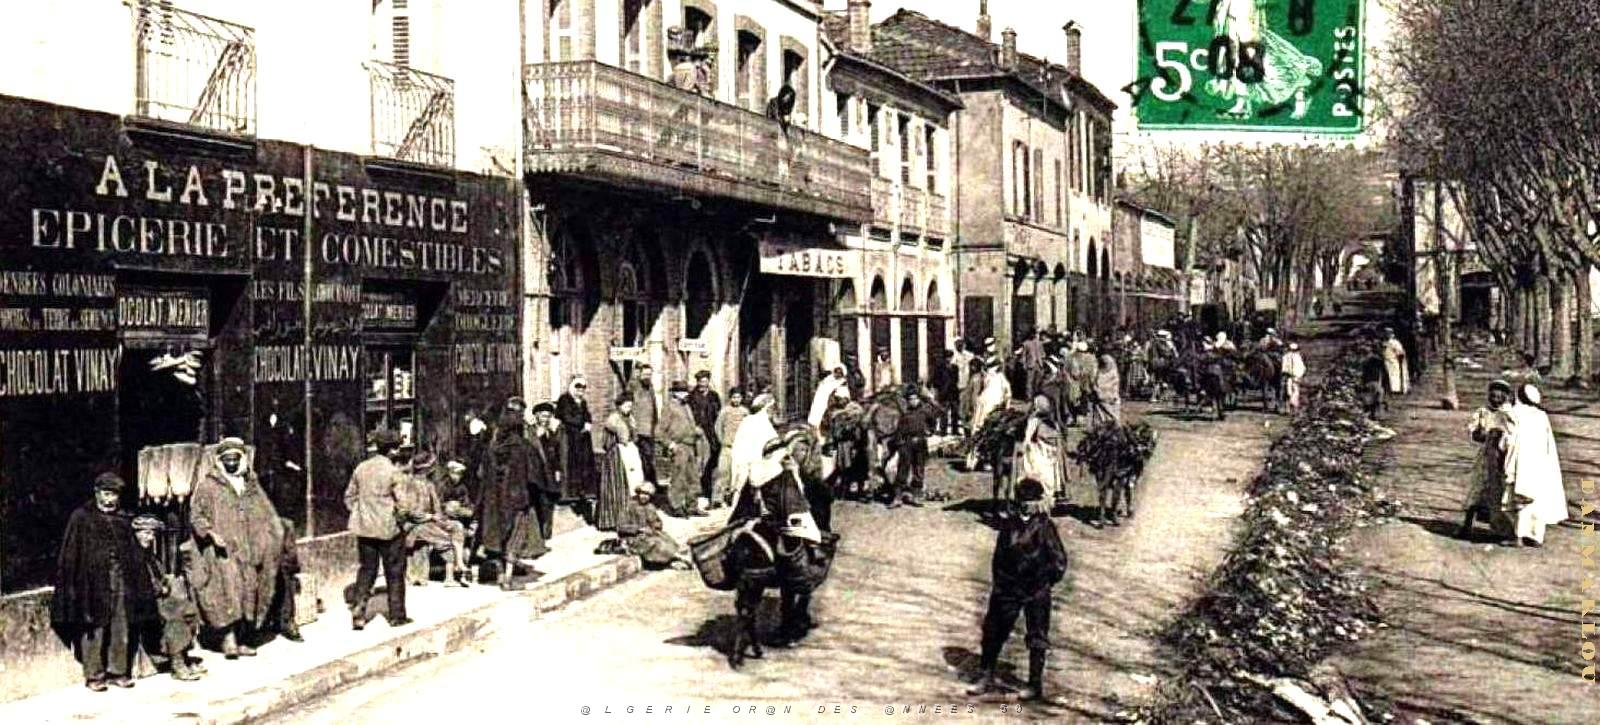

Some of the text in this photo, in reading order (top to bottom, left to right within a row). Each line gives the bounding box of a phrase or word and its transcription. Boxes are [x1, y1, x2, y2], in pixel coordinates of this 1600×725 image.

[1332, 26, 1356, 117] POSTES
[95, 155, 129, 197] A
[222, 168, 468, 233] PREFERENCE
[32, 208, 501, 274] EPICERIE ET COMESTIBLES
[119, 297, 164, 326] OCOLAT
[0, 346, 119, 396] CHOCOLAT VINAY
[312, 345, 359, 381] VINAY
